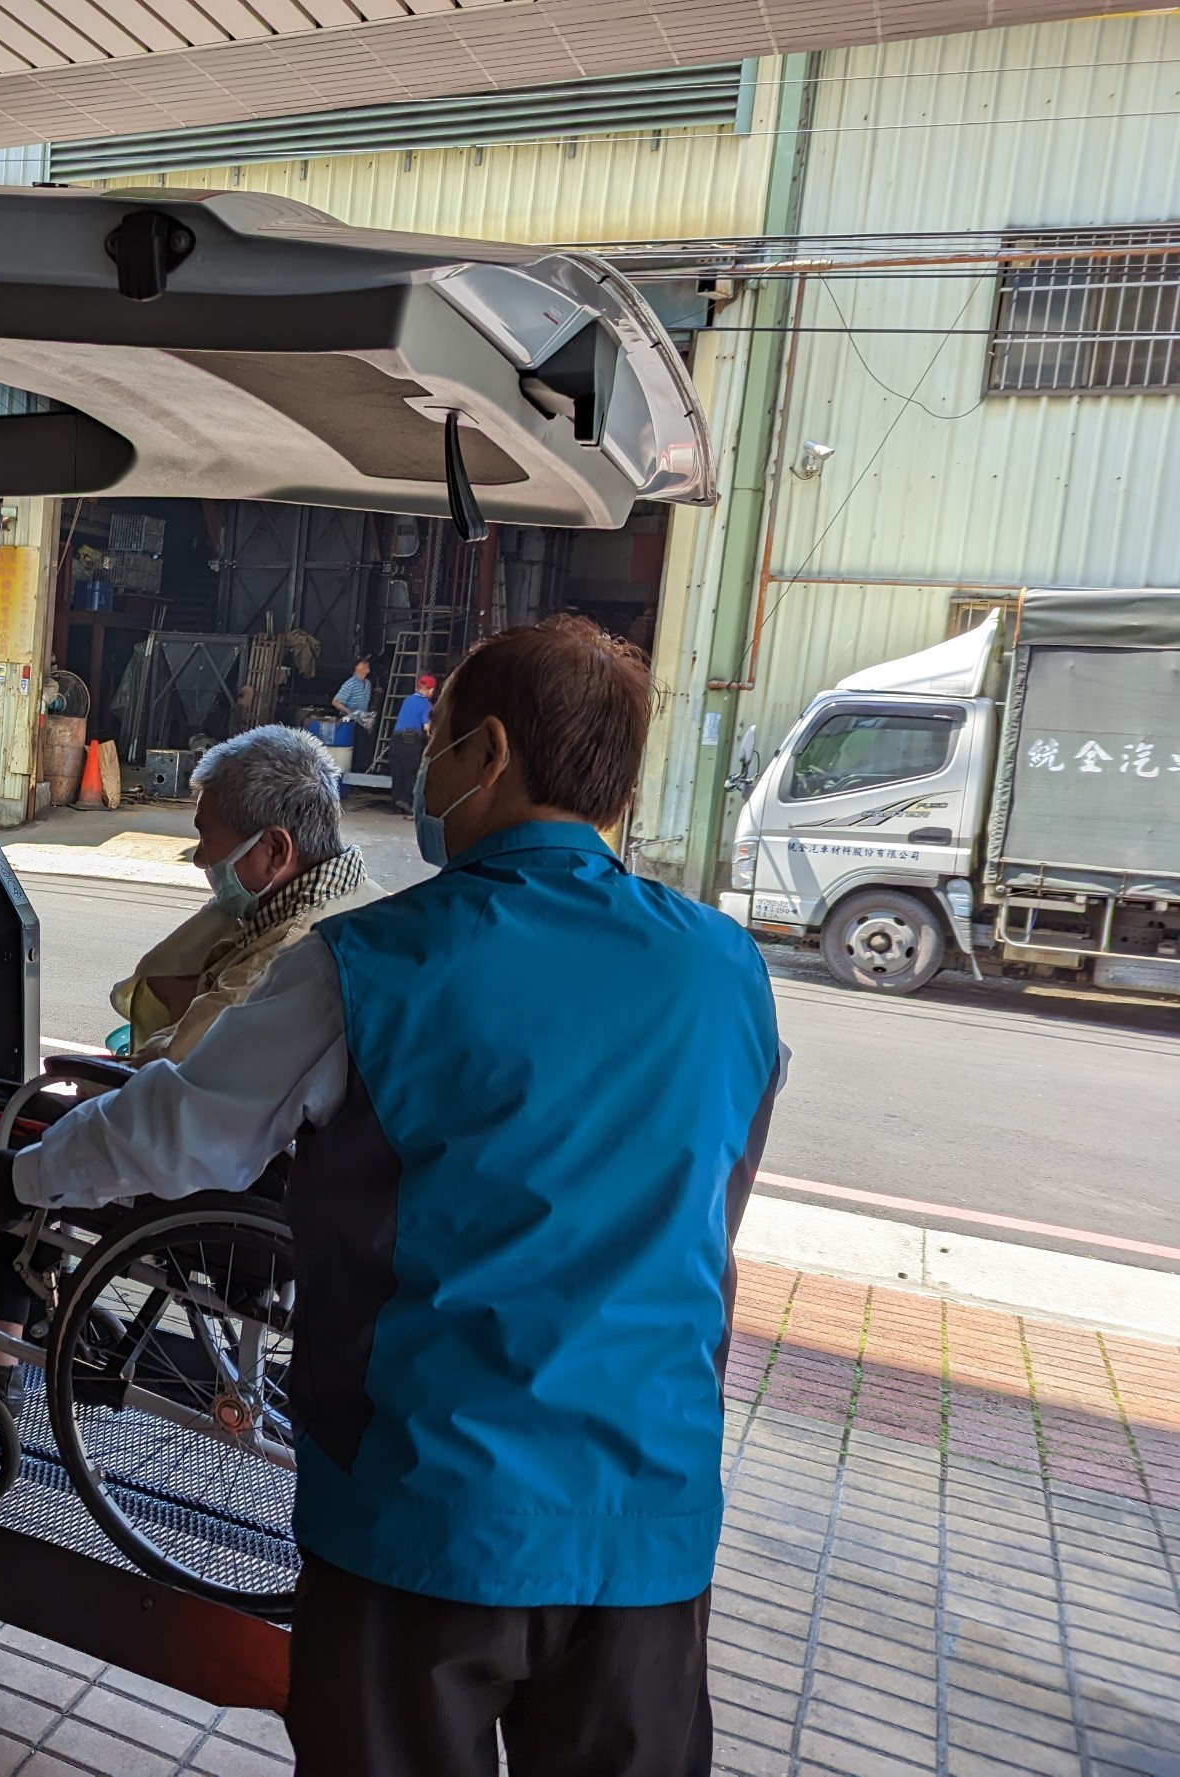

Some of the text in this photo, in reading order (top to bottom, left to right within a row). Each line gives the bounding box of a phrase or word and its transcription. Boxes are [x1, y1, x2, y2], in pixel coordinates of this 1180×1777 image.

[787, 842, 920, 861] 統全汽車材料股份有限公司
